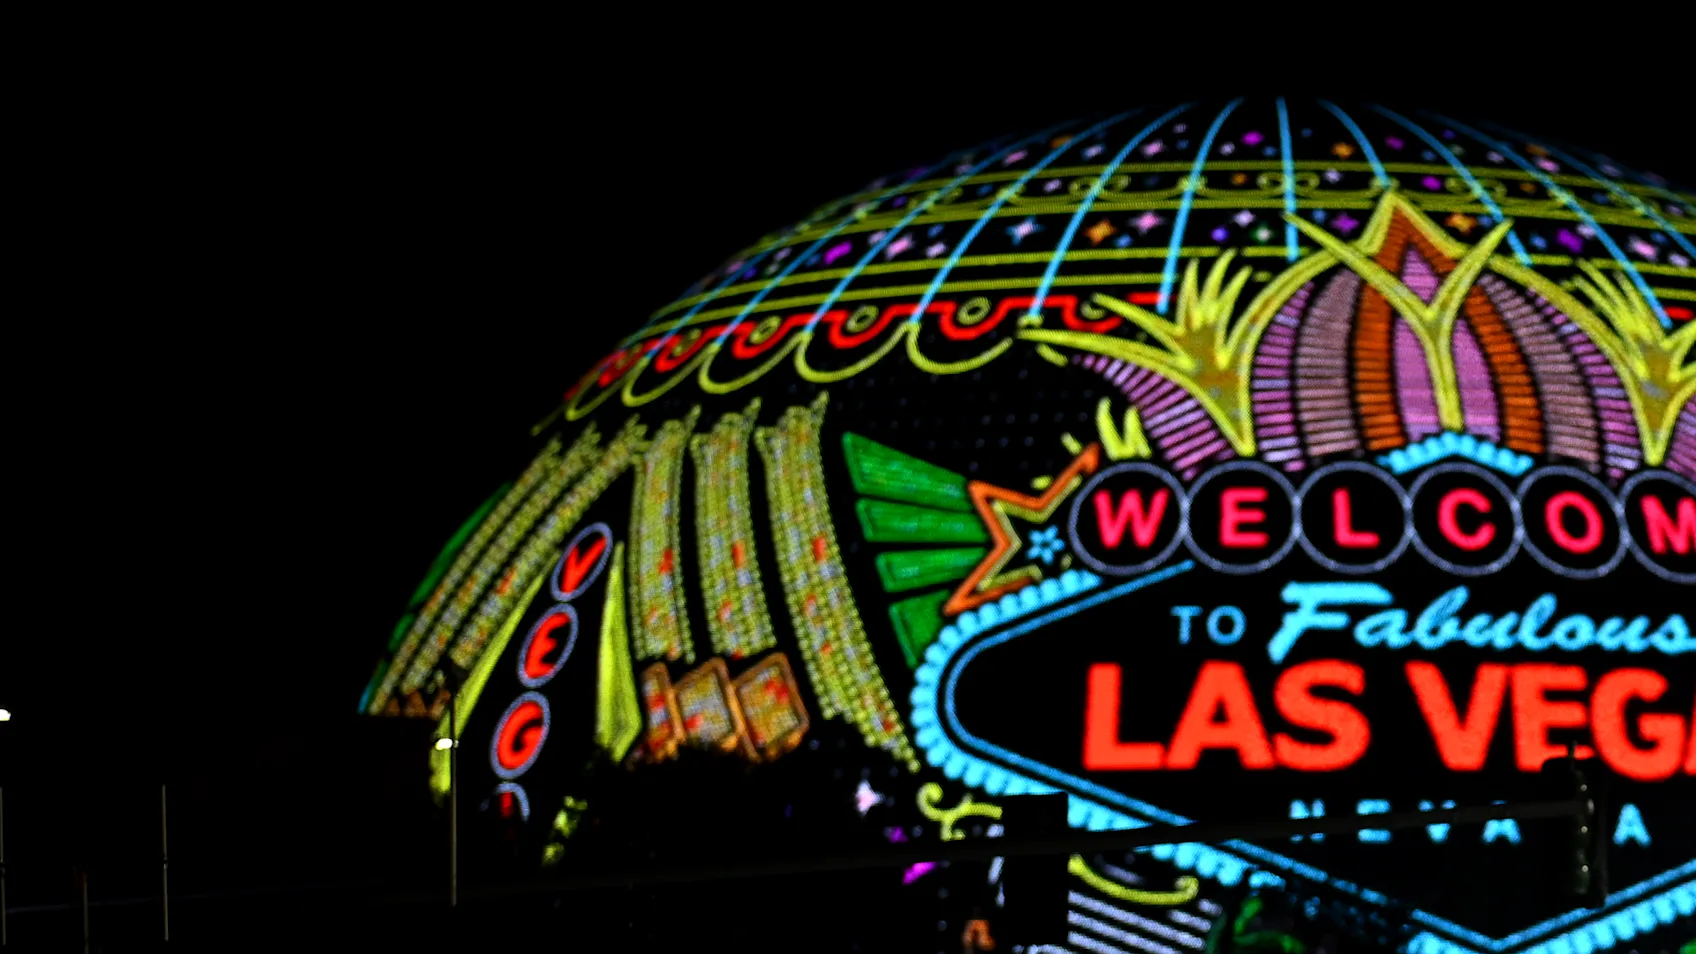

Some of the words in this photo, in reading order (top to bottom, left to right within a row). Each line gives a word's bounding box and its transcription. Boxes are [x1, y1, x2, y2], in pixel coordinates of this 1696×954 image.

[1172, 605, 1246, 646] TO
[494, 535, 610, 814] VEG
[1082, 657, 1371, 773] LAS
[1289, 798, 1652, 846] NEVAA
